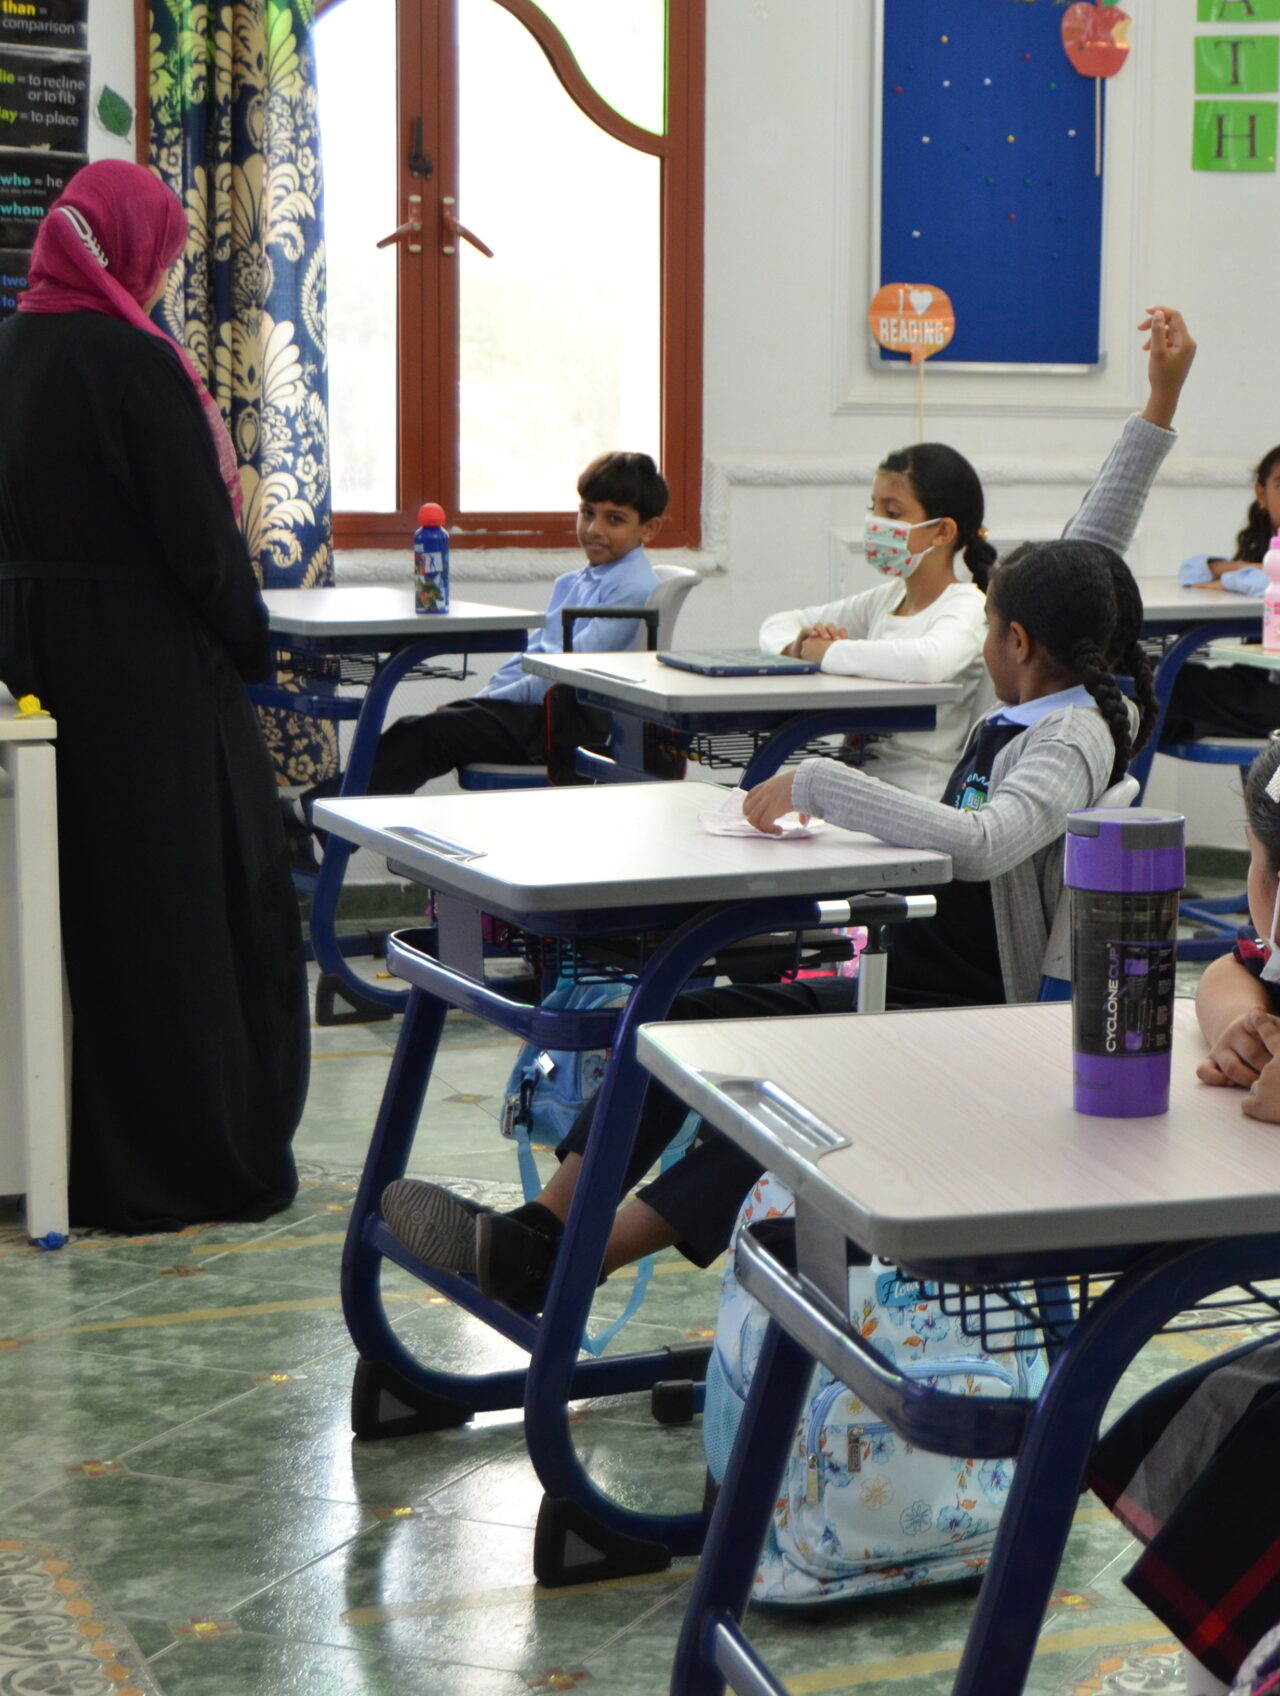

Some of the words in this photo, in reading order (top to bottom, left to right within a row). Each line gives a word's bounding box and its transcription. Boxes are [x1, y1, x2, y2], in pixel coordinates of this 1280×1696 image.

[2, 0, 36, 16] than
[2, 18, 76, 35] comparison
[0, 68, 15, 84] lie
[28, 73, 41, 87] to
[43, 74, 87, 91] recline
[28, 90, 42, 102] or
[44, 89, 57, 104] to
[59, 89, 77, 105] fib
[31, 110, 44, 123] to
[45, 110, 80, 127] place
[0, 171, 32, 188] who
[46, 172, 64, 189] he
[0, 200, 45, 217] whom
[2, 273, 29, 288] two
[898, 288, 905, 316] I
[880, 317, 945, 345] READING
